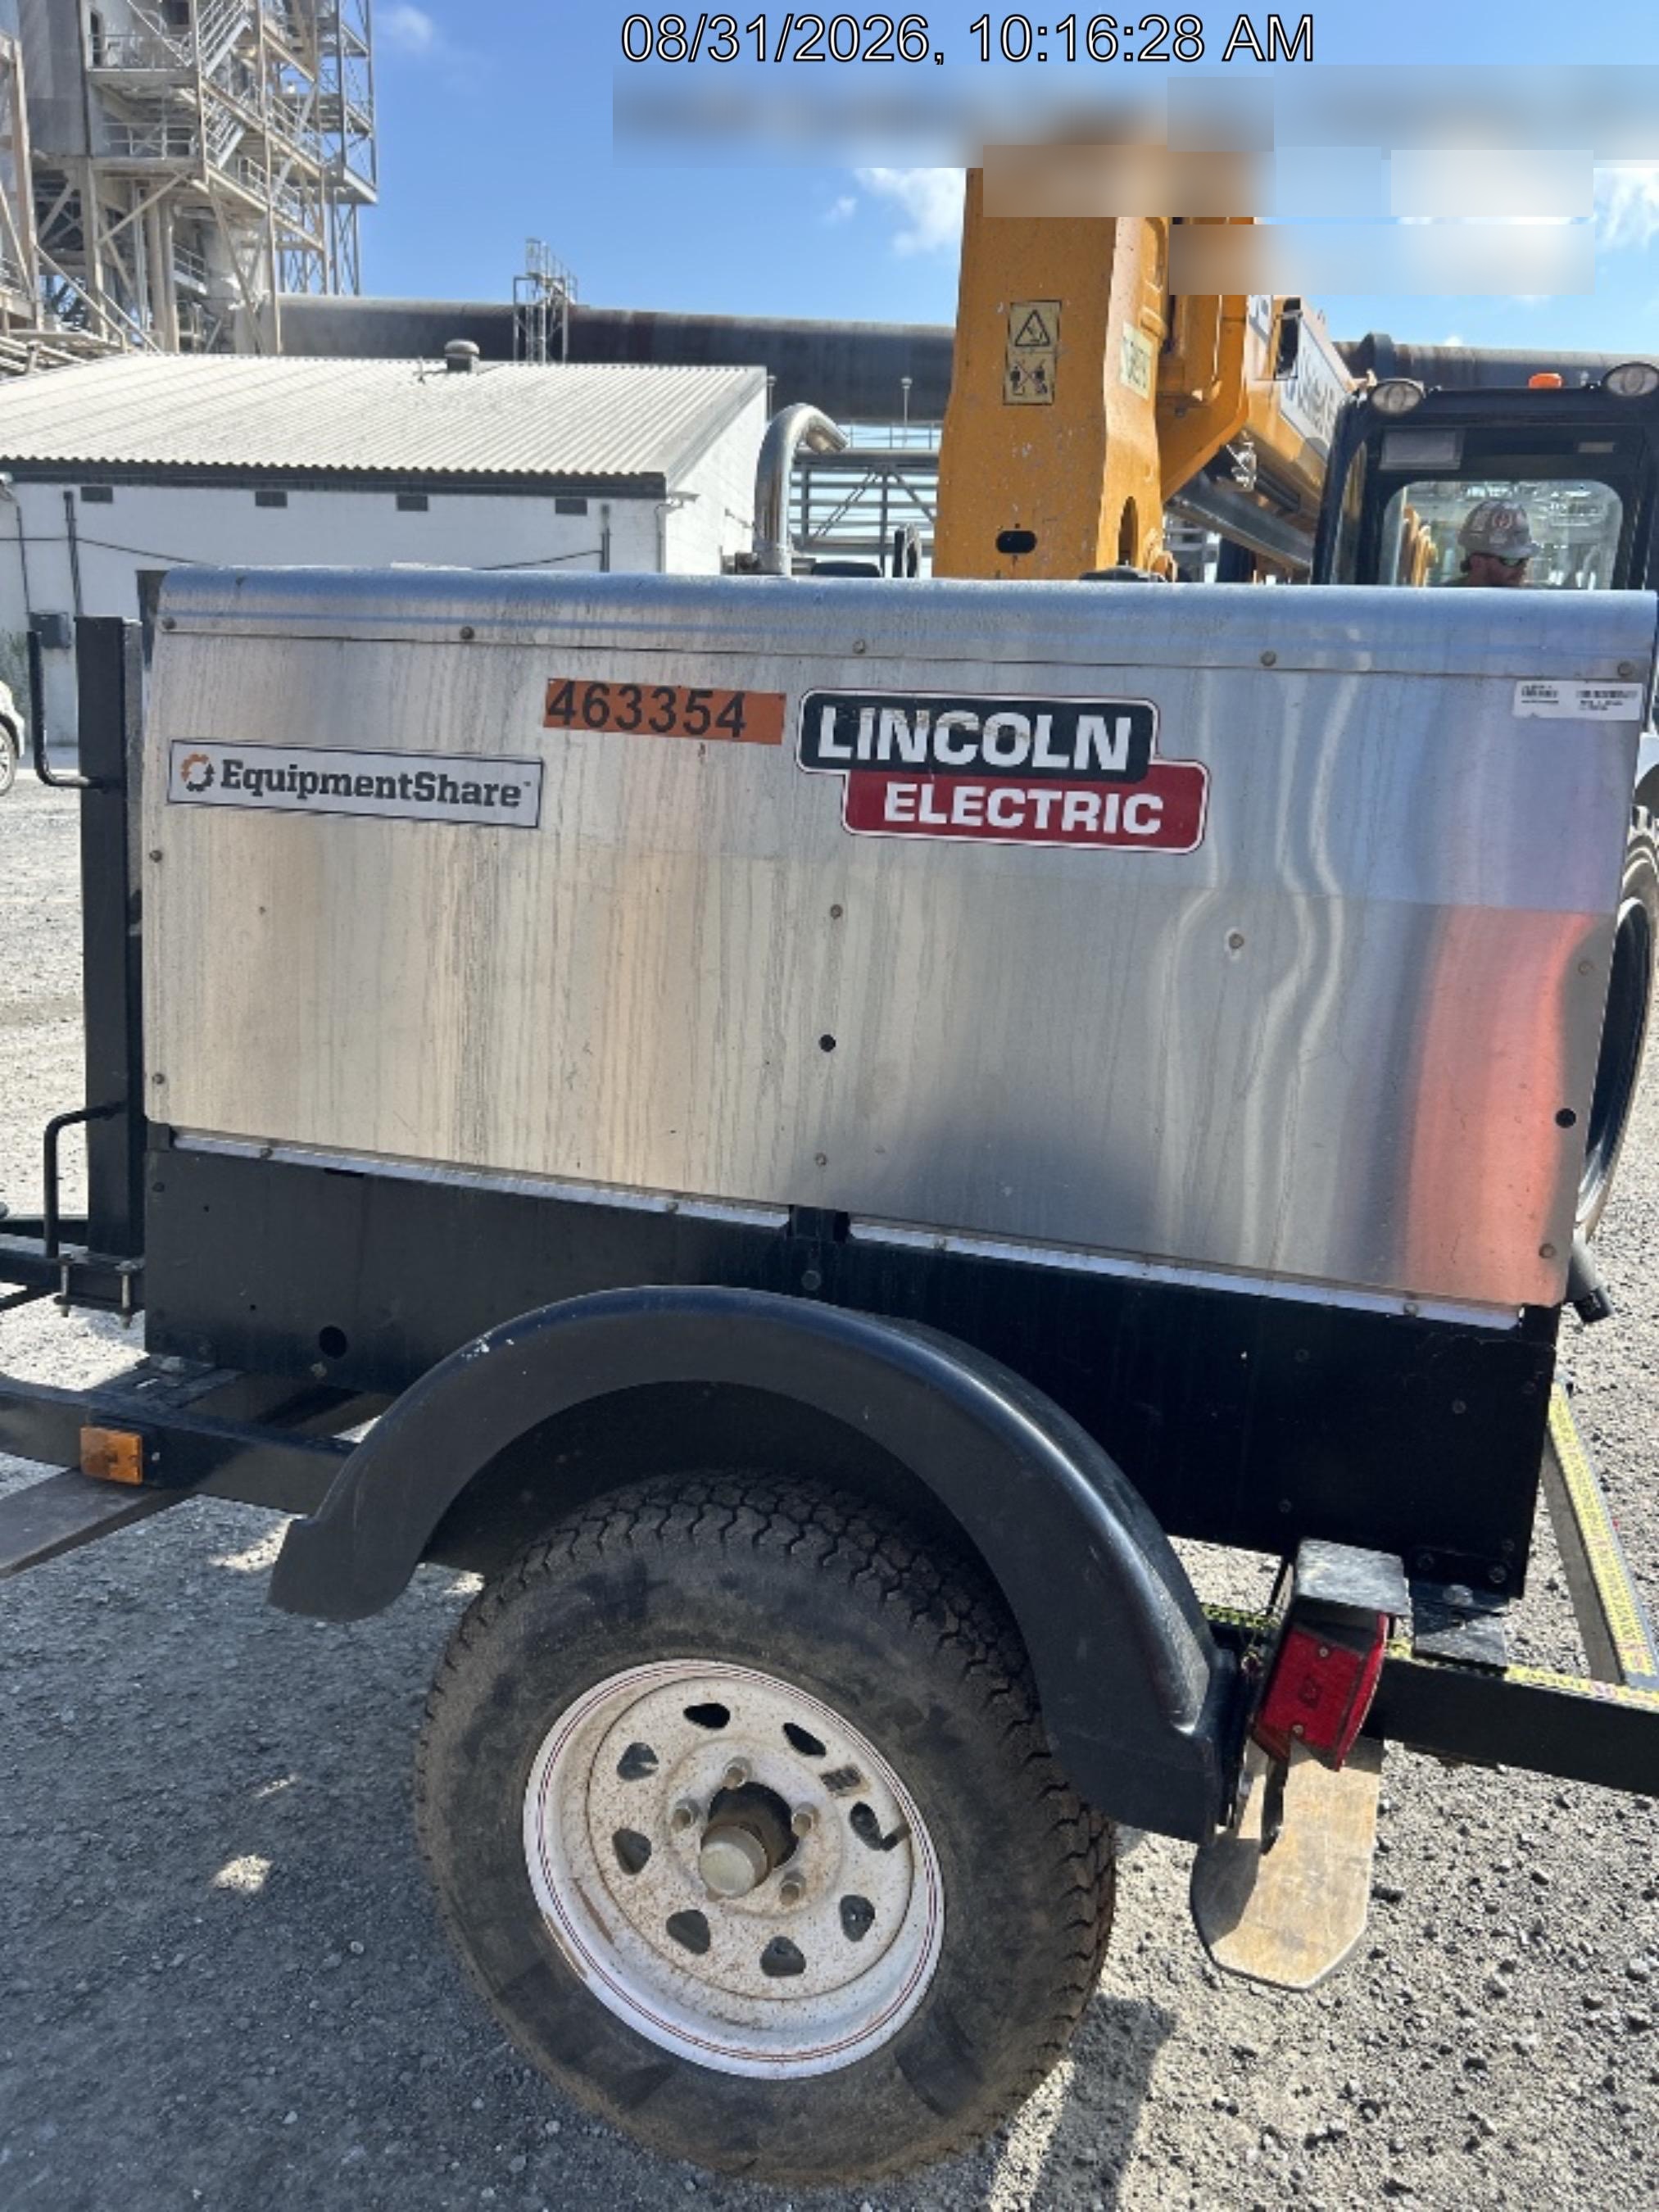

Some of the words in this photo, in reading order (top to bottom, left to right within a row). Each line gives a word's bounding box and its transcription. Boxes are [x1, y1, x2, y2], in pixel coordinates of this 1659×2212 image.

[547, 681, 747, 737] 463354
[818, 705, 1131, 771] LINCOLN
[220, 759, 522, 807] EquipmentShare
[884, 782, 1163, 834] ELECTRIC
